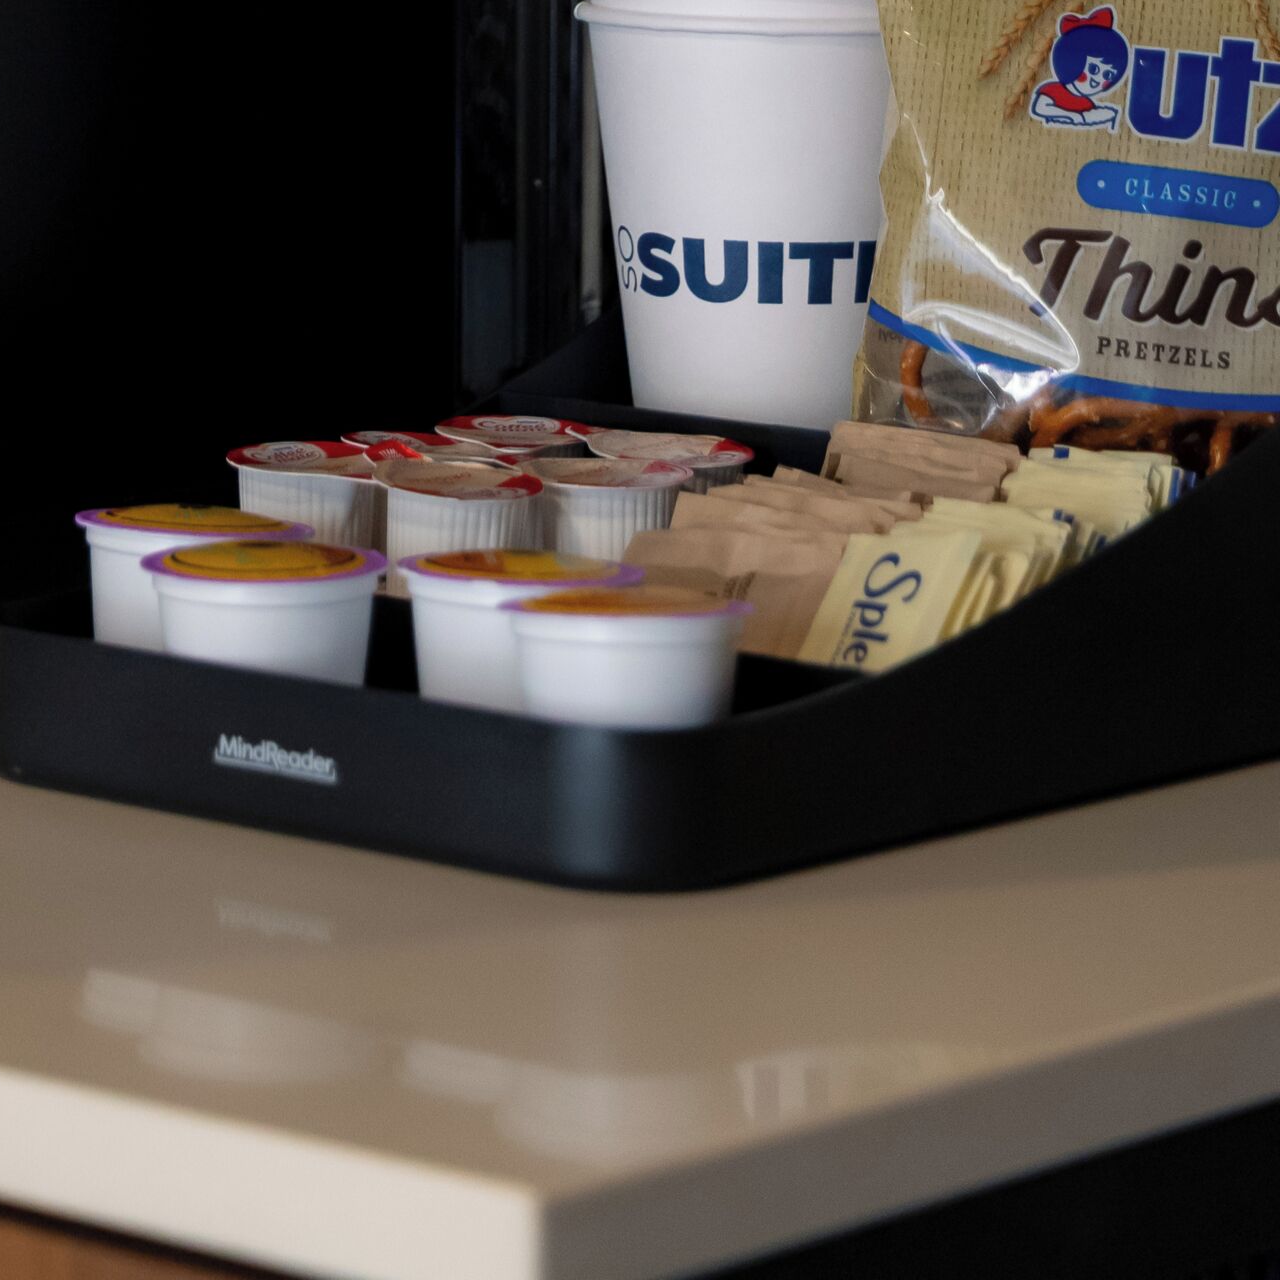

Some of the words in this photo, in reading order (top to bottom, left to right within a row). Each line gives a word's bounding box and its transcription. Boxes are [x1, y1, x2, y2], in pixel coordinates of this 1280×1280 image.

[1124, 178, 1237, 210] CLASSIC
[1096, 335, 1232, 370] PRETZELS
[219, 732, 335, 774] MindReader
